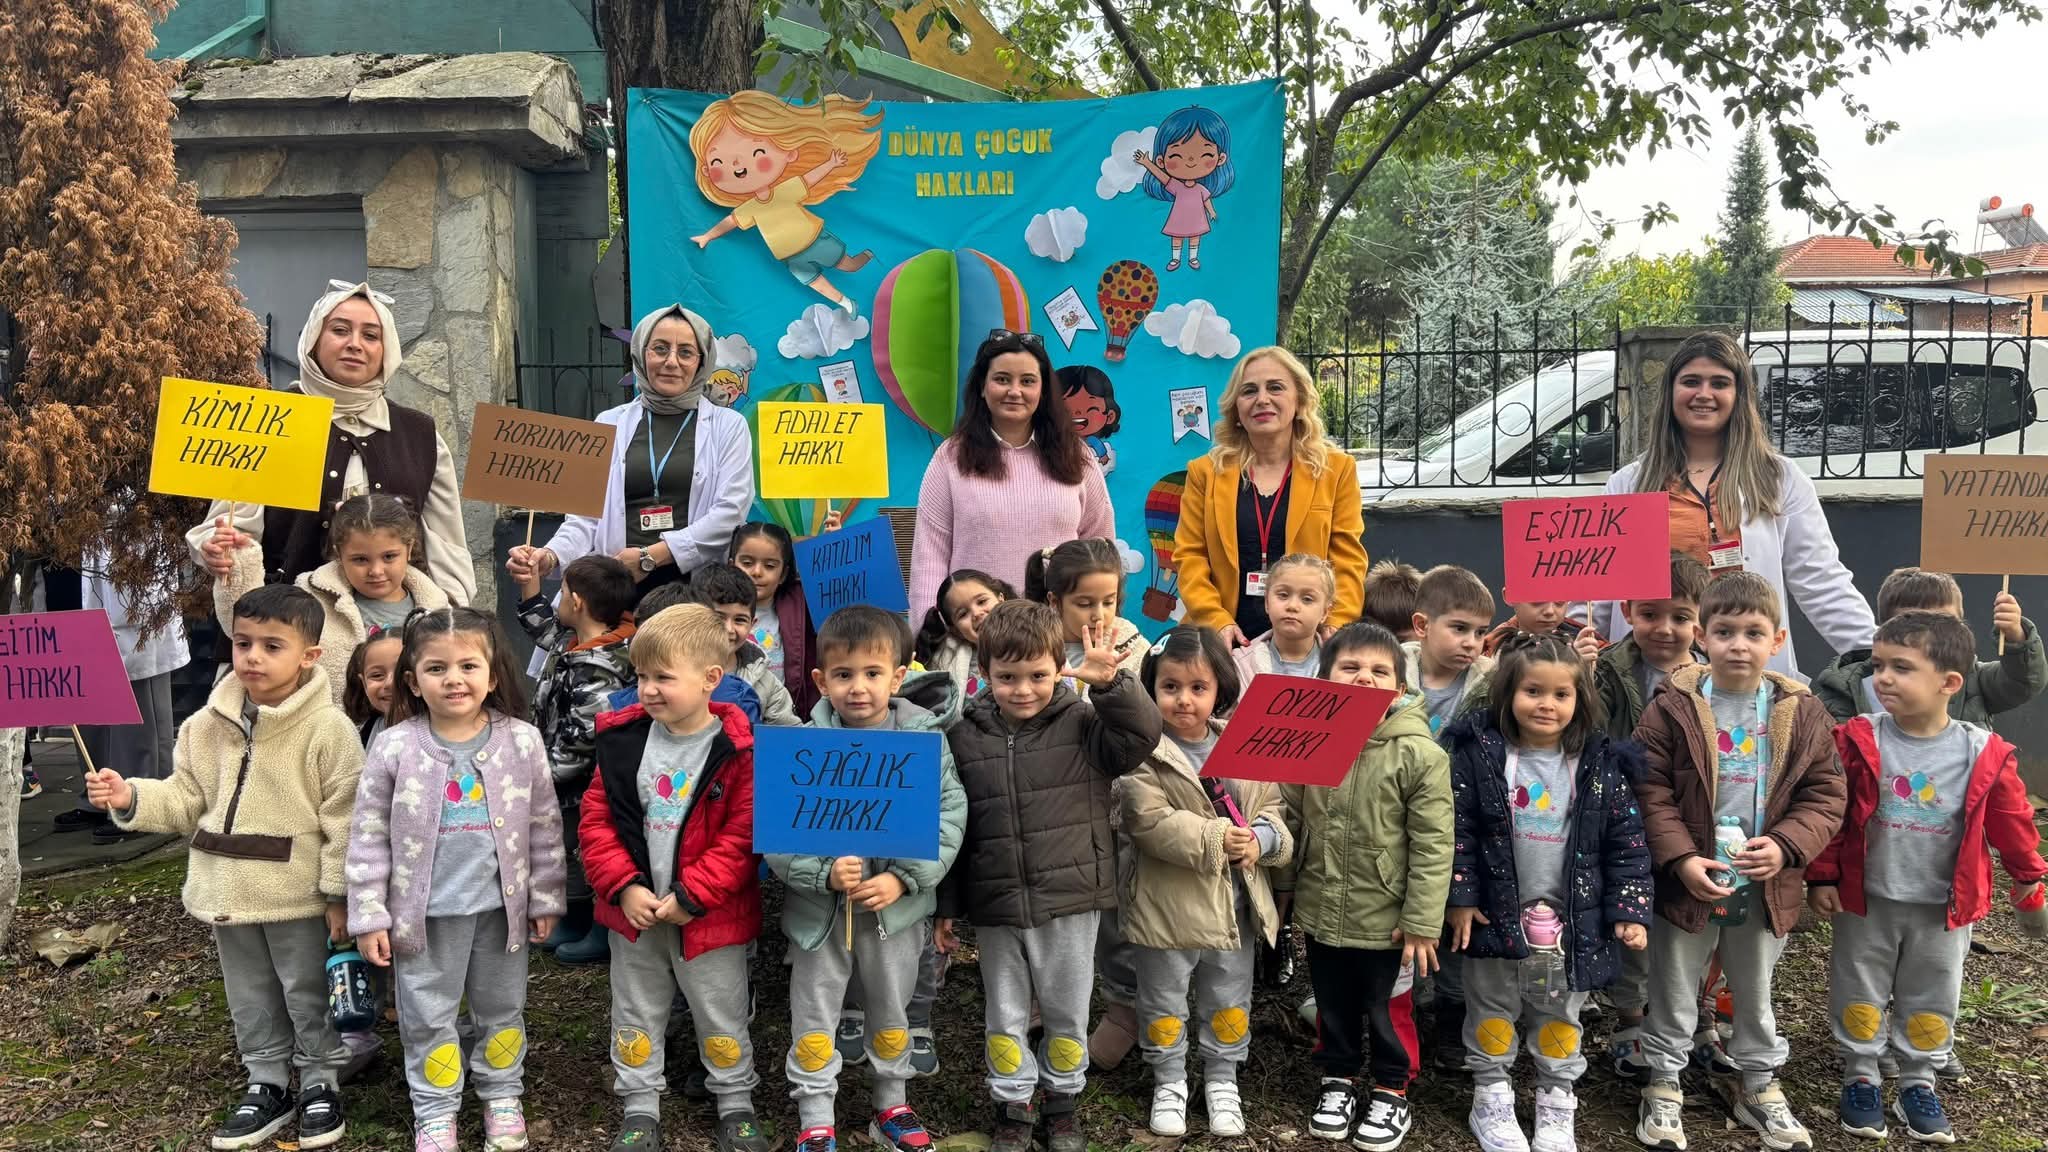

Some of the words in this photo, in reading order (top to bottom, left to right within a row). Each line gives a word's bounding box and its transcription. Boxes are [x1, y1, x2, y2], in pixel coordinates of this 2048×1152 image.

[887, 125, 963, 157] DÜNYA
[975, 128, 1053, 160] ÇOCUK
[916, 171, 1014, 197] HAKLARI
[774, 405, 863, 434] ADALET
[179, 436, 268, 472] HAKKI
[493, 419, 607, 458] KORUNMA
[778, 441, 844, 465] HAKKI
[485, 451, 564, 484] HAKKI
[1526, 502, 1629, 543] EŞİTLİK
[811, 531, 872, 577] KATILIM
[1532, 546, 1616, 578] HAKKI
[817, 570, 867, 608] HAKKI
[3, 664, 88, 700] HAKKI
[1266, 688, 1352, 720] OYUN
[1235, 726, 1332, 760] HAKKI
[790, 741, 920, 789] SAĞLIK
[792, 794, 893, 832] HAKKI
